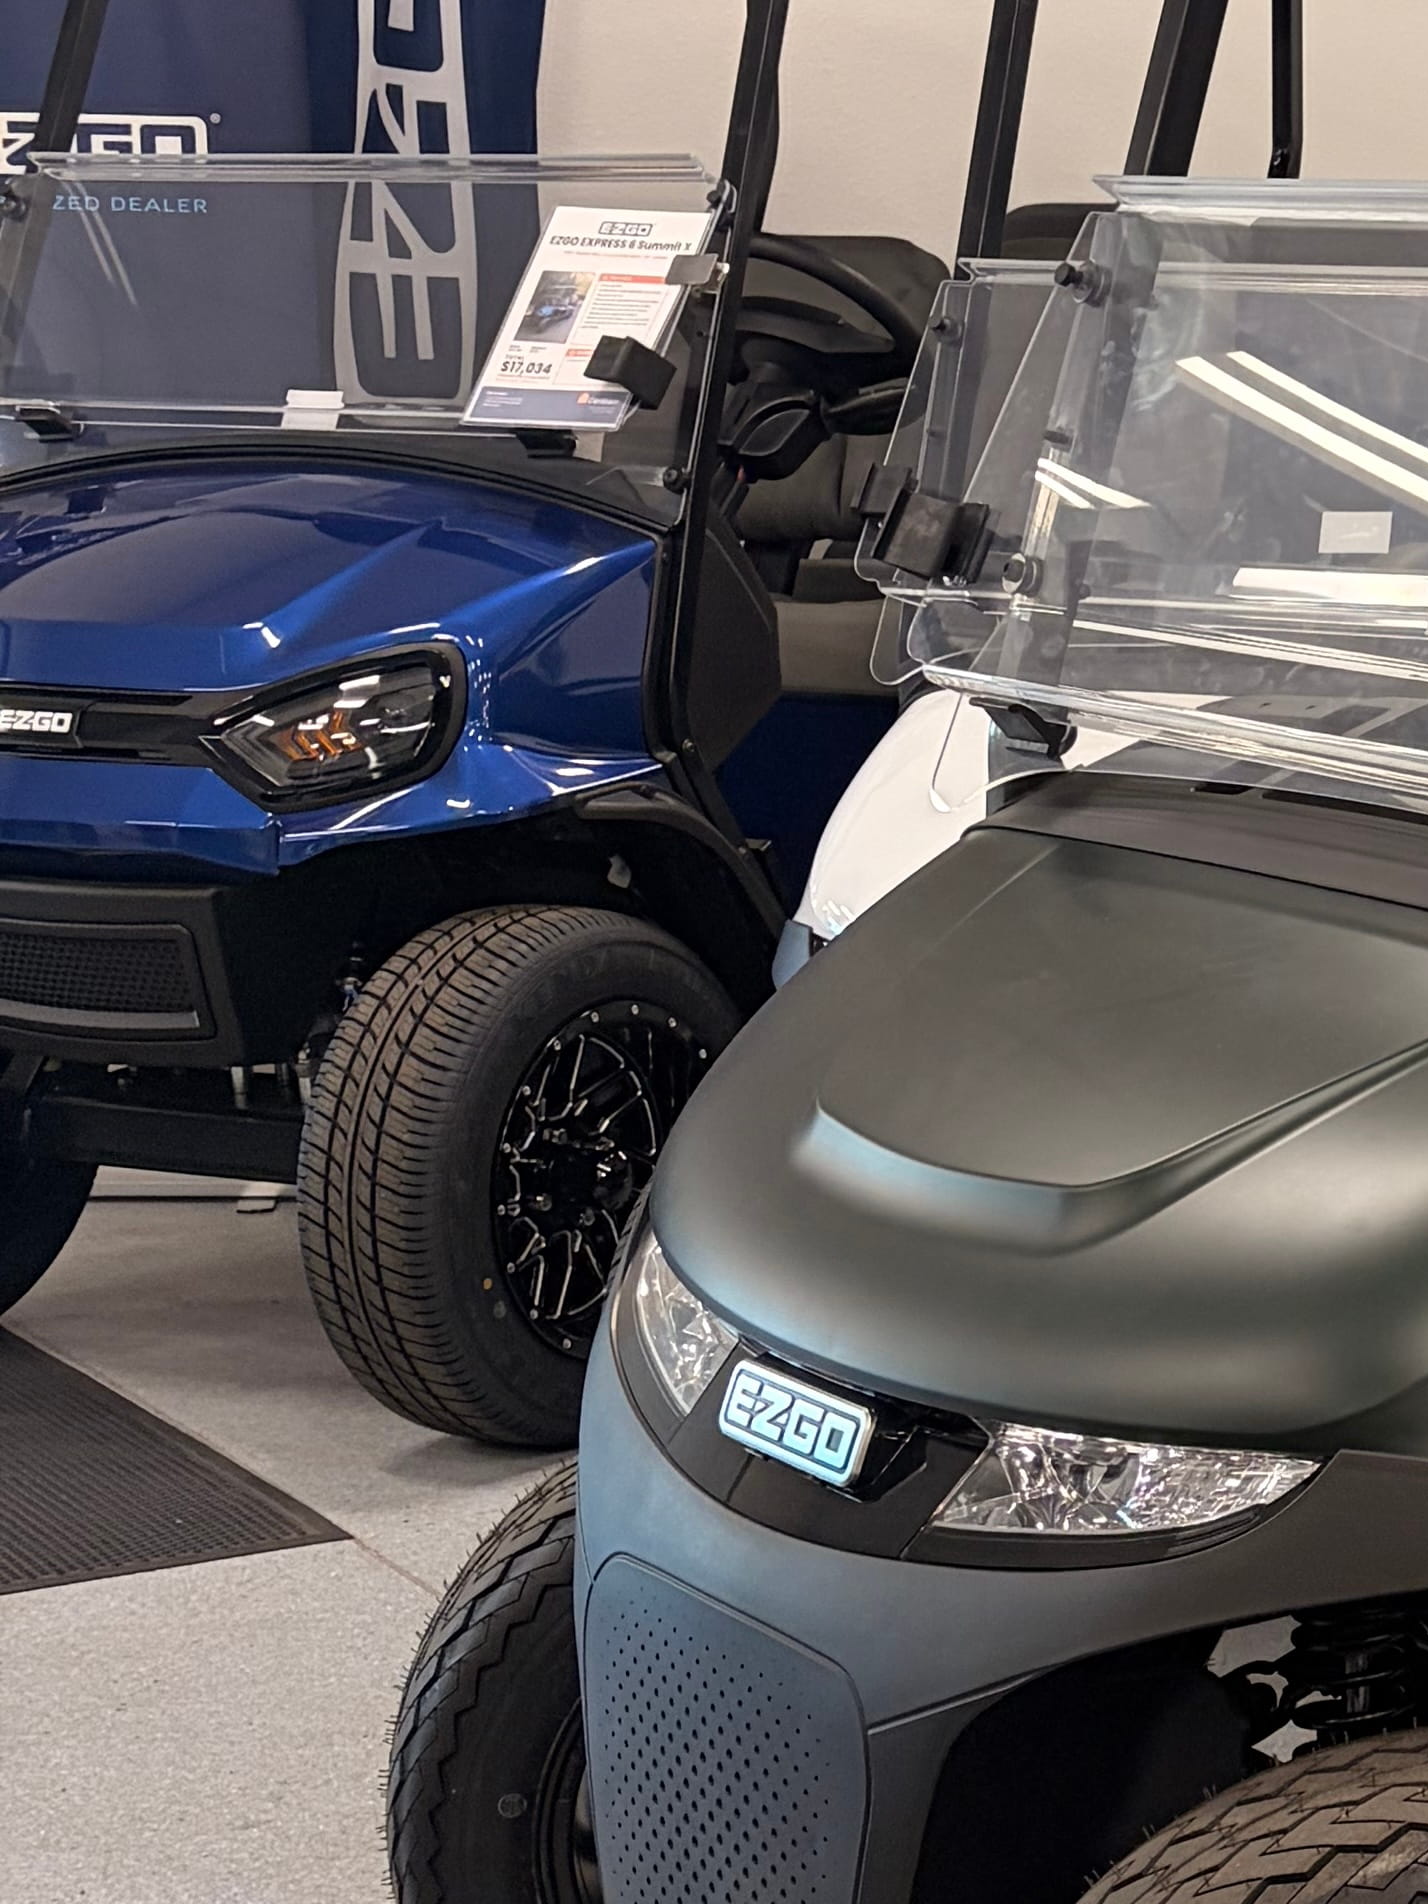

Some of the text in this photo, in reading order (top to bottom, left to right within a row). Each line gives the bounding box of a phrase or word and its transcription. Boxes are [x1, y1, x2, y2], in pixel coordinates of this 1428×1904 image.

[53, 195, 208, 213] ZED DEALER
[550, 235, 580, 247] EZGO
[580, 237, 626, 249] EXPRESS
[637, 240, 682, 252] Summit
[500, 361, 552, 375] $17,034
[0, 709, 73, 733] EZGO
